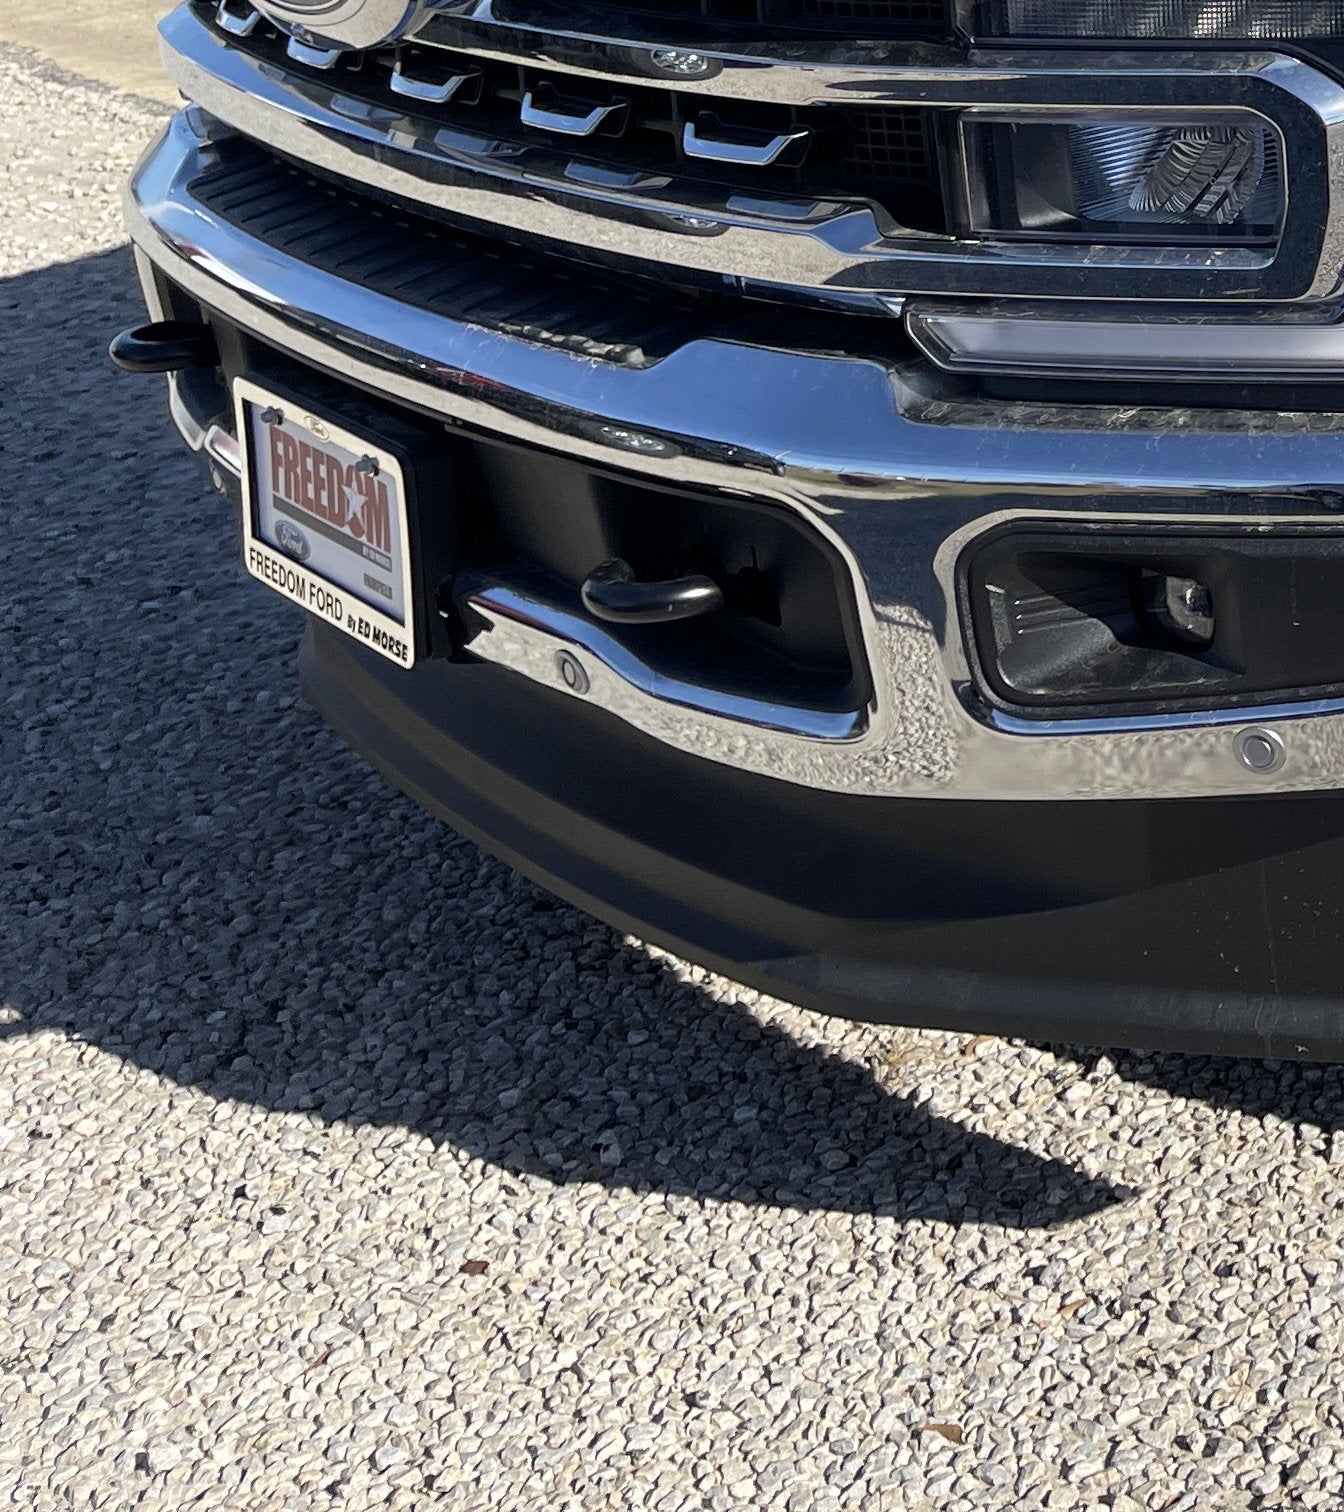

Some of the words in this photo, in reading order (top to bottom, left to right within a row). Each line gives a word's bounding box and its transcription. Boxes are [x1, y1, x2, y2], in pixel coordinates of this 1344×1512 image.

[269, 424, 391, 554] FREEDOM
[249, 546, 306, 600] FREEDOM
[308, 585, 343, 622] FORD
[357, 617, 371, 639] ED
[372, 624, 408, 662] MORSE
